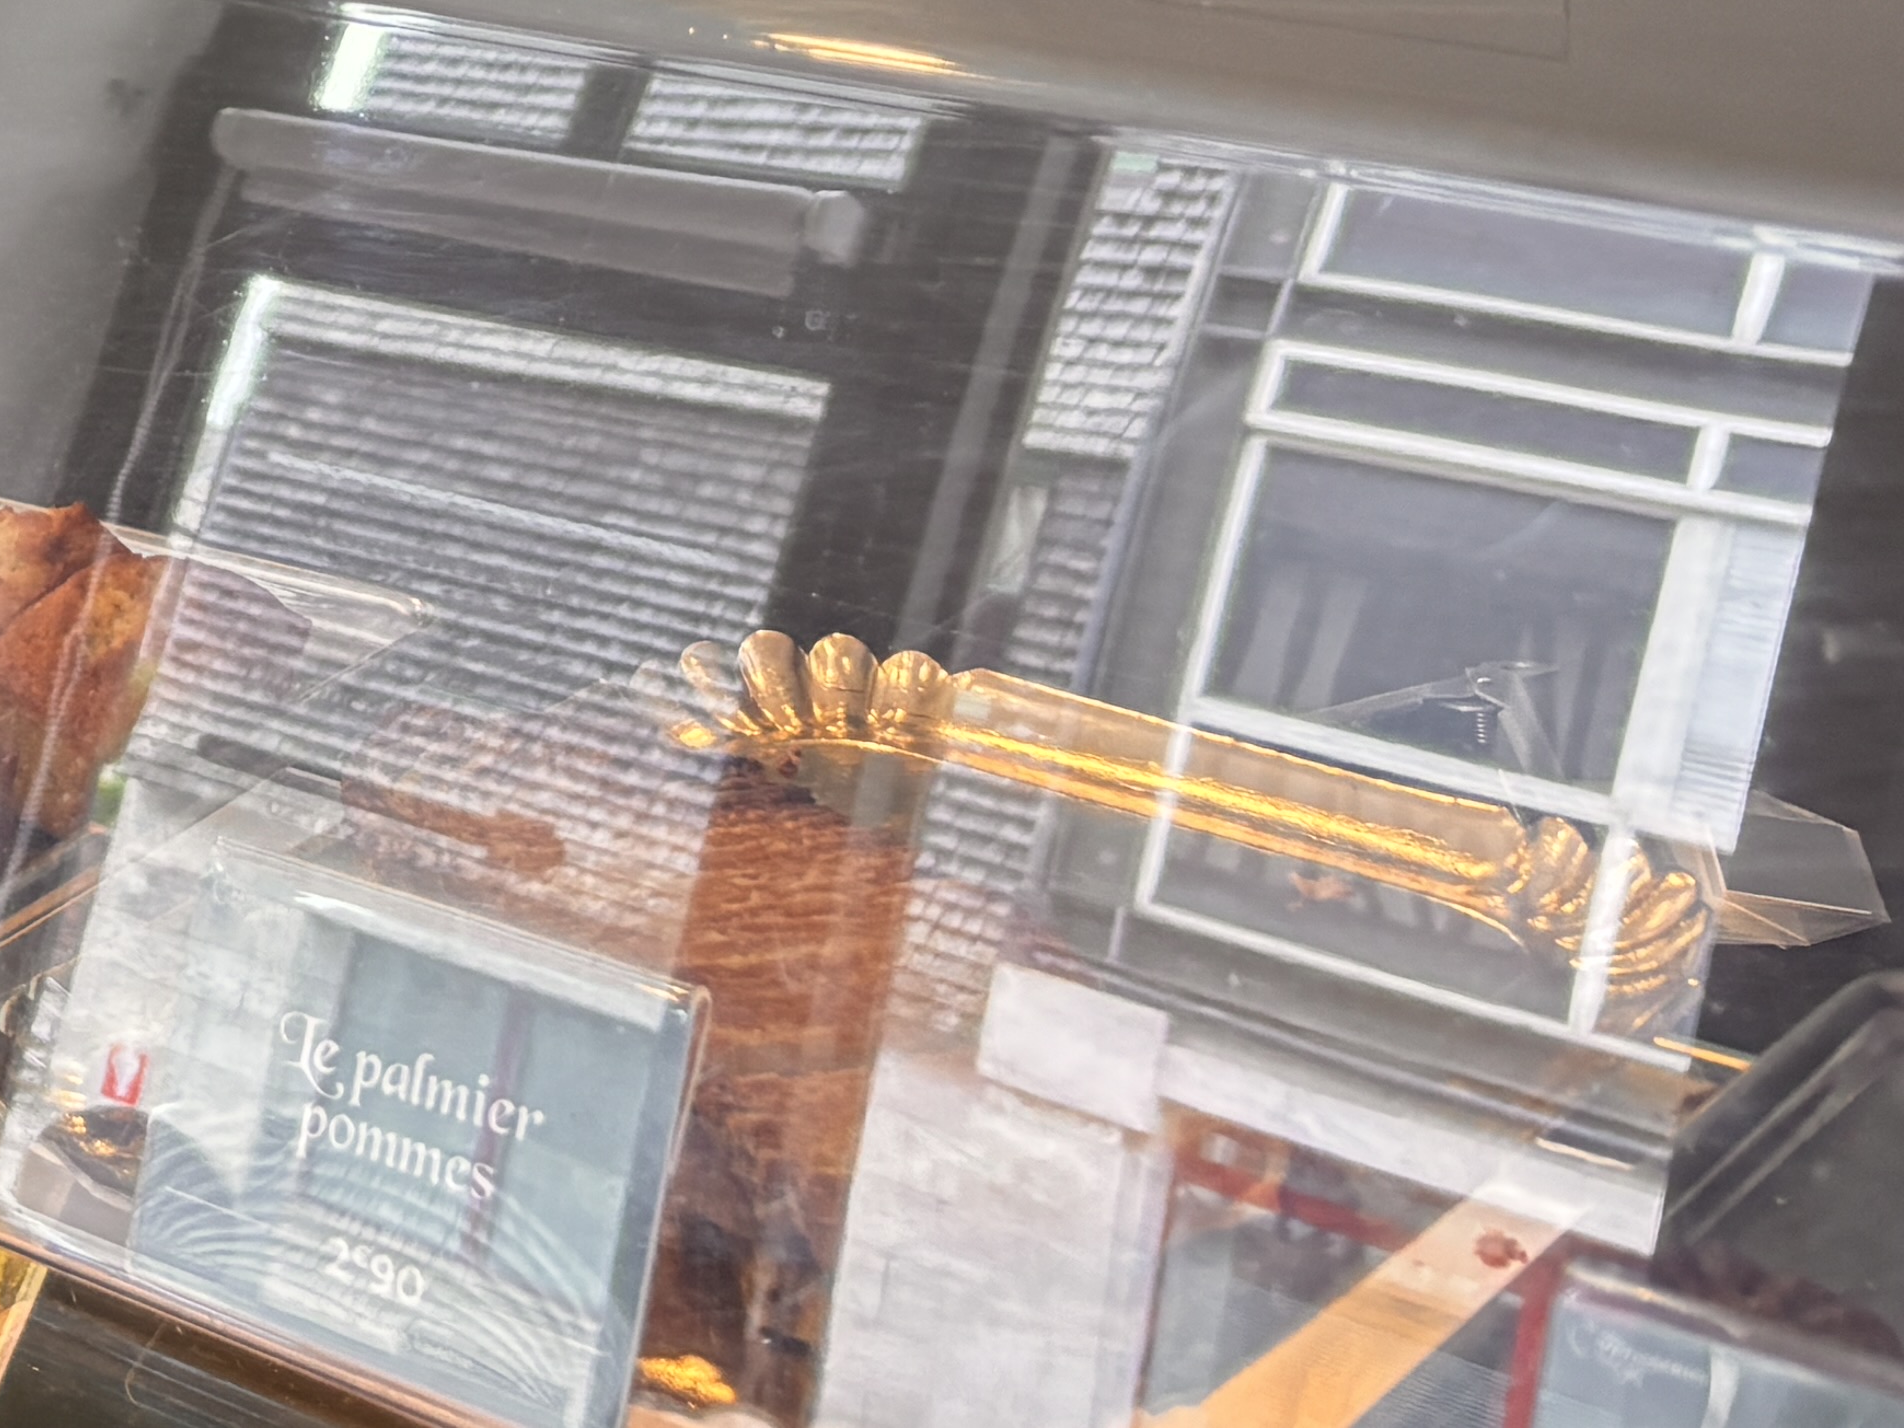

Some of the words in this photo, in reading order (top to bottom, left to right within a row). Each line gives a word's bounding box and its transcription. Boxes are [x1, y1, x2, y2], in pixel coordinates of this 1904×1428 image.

[279, 1010, 345, 1101] Le
[348, 1051, 546, 1142] palmier
[295, 1102, 500, 1201] pommes
